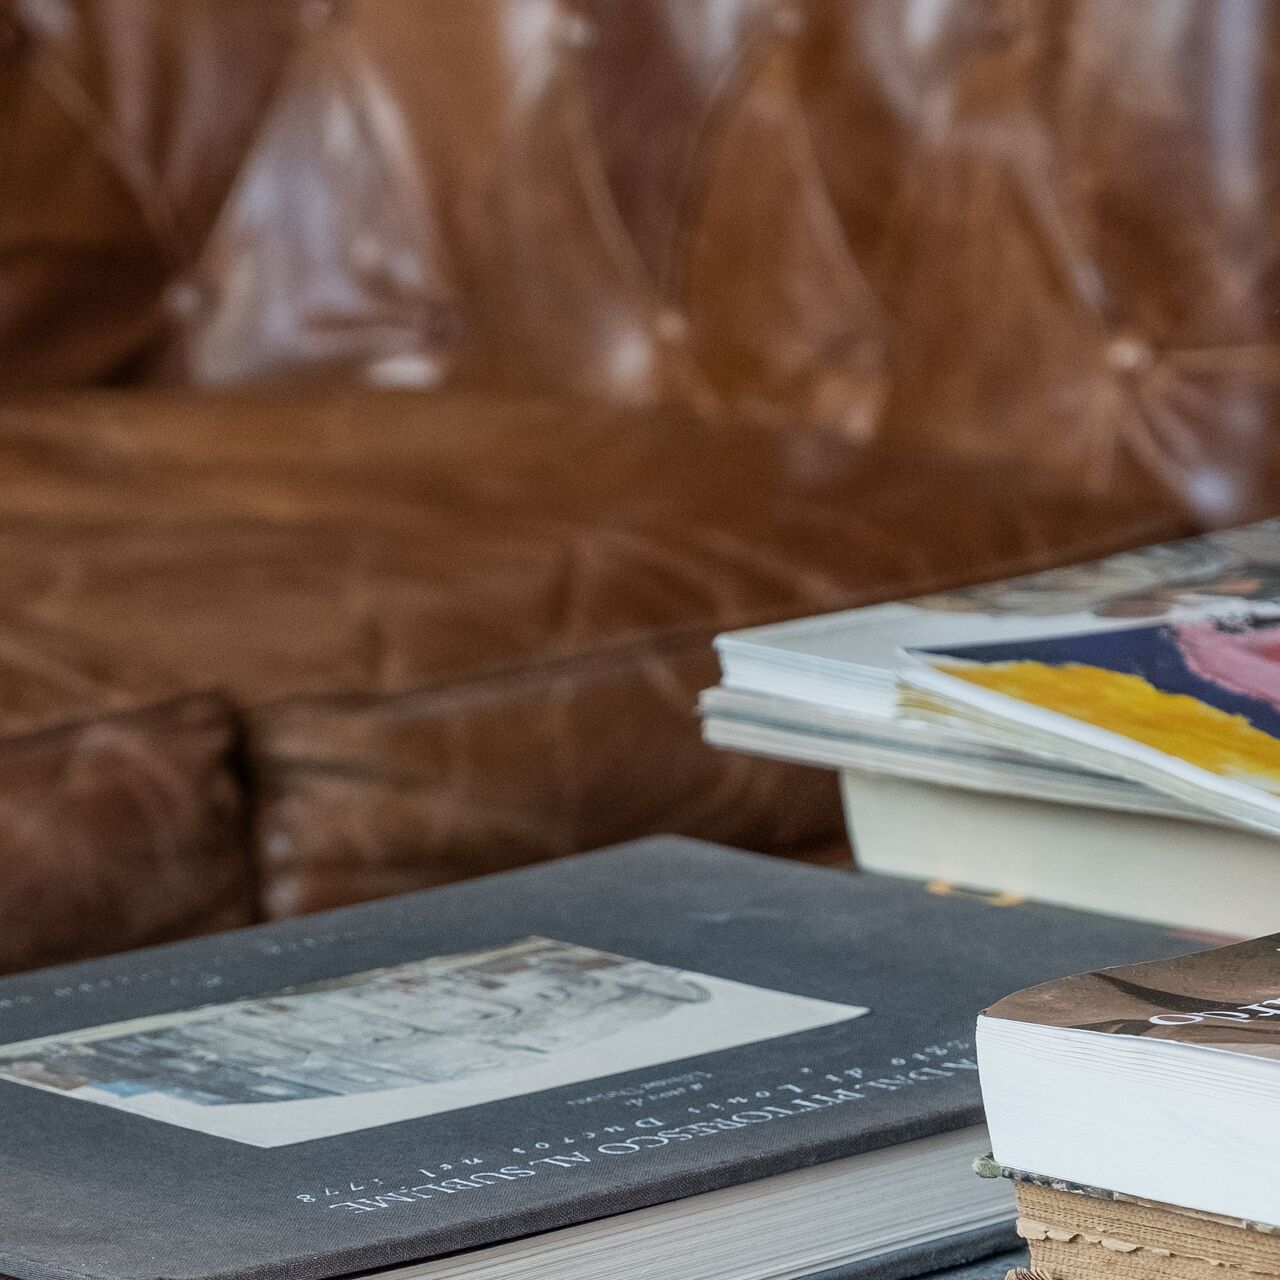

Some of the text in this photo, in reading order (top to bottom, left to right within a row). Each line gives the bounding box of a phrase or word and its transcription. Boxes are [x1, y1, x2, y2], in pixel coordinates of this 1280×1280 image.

[685, 1082, 804, 1115] Louis
[511, 1115, 666, 1155] Ducros
[598, 1086, 867, 1156] PITTORESCO
[418, 1156, 484, 1178] nel
[529, 1148, 593, 1169] AL
[328, 1165, 537, 1215] SUBLIME
